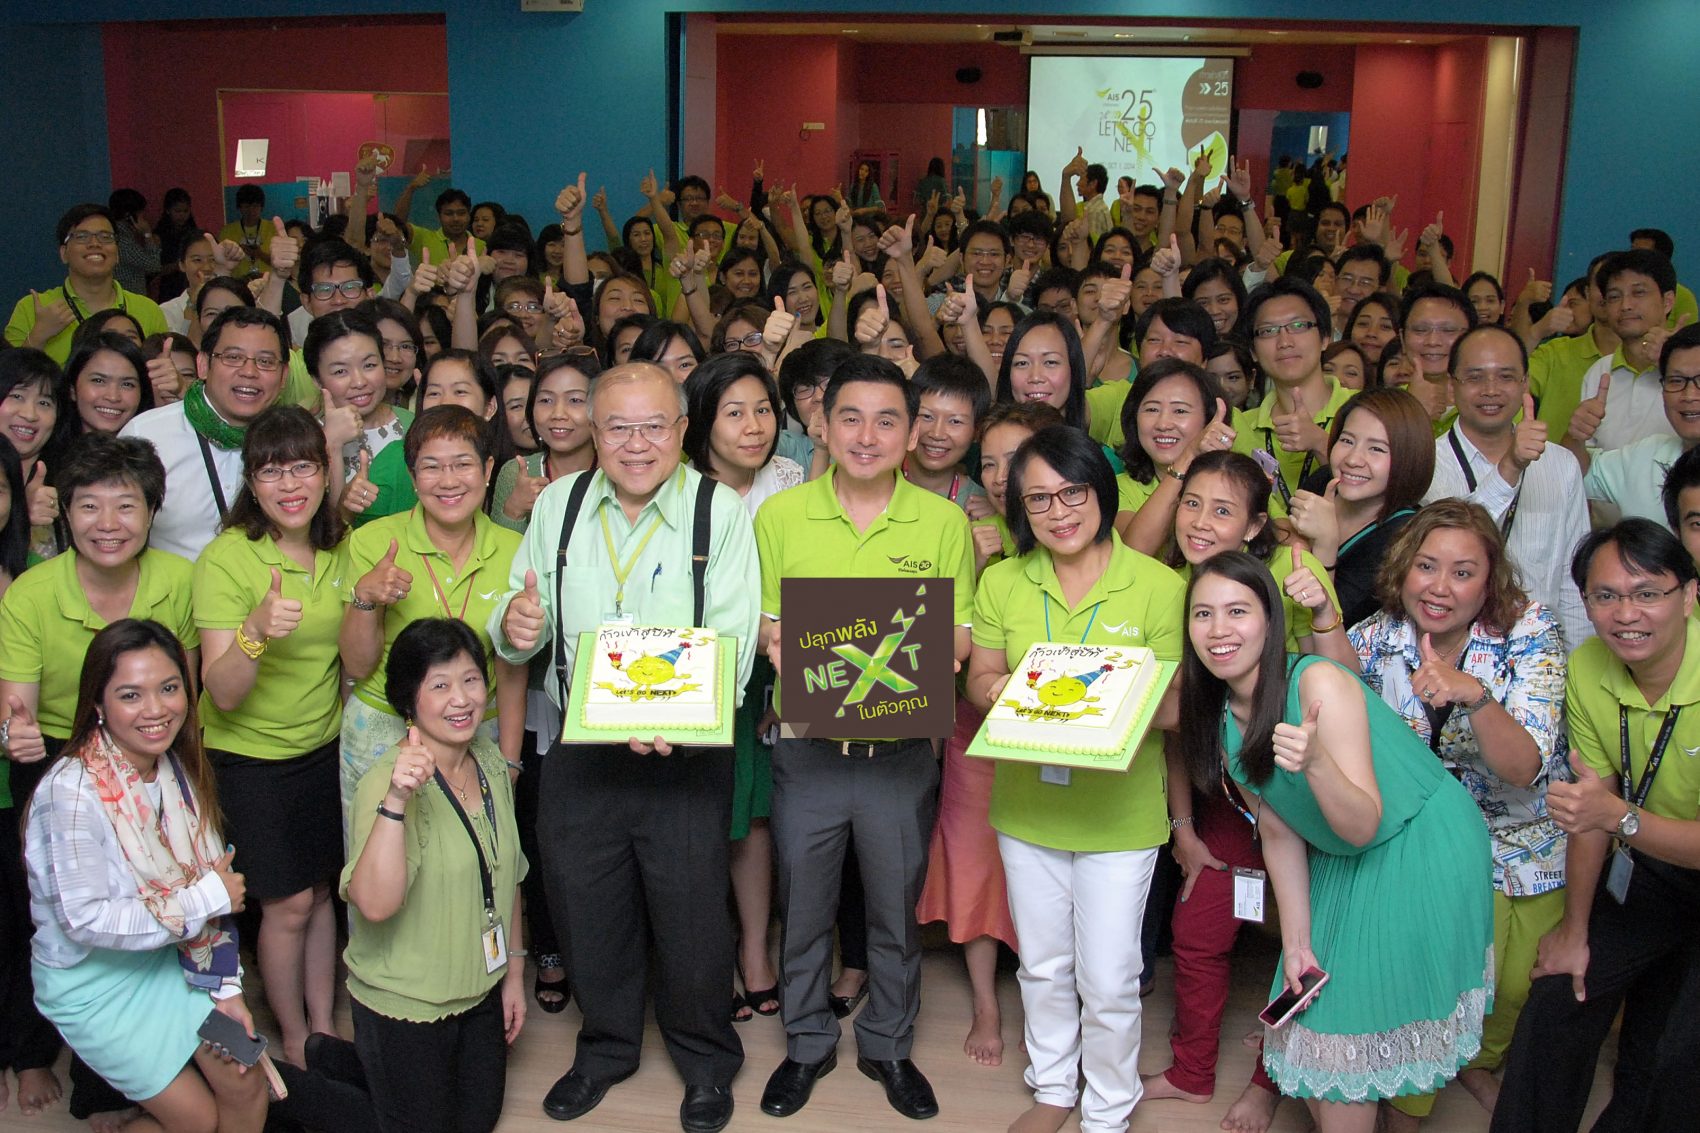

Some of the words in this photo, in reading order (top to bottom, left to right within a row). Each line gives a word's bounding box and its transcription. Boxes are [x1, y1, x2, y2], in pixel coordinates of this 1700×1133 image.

[1214, 81, 1229, 96] 25
[903, 560, 918, 568] AIS
[799, 618, 878, 650] ปลุกพลัง
[1121, 626, 1139, 638] AIS
[803, 631, 922, 706] NEXT
[857, 695, 928, 721] ในตัวคุณ
[1534, 871, 1562, 881] STREET
